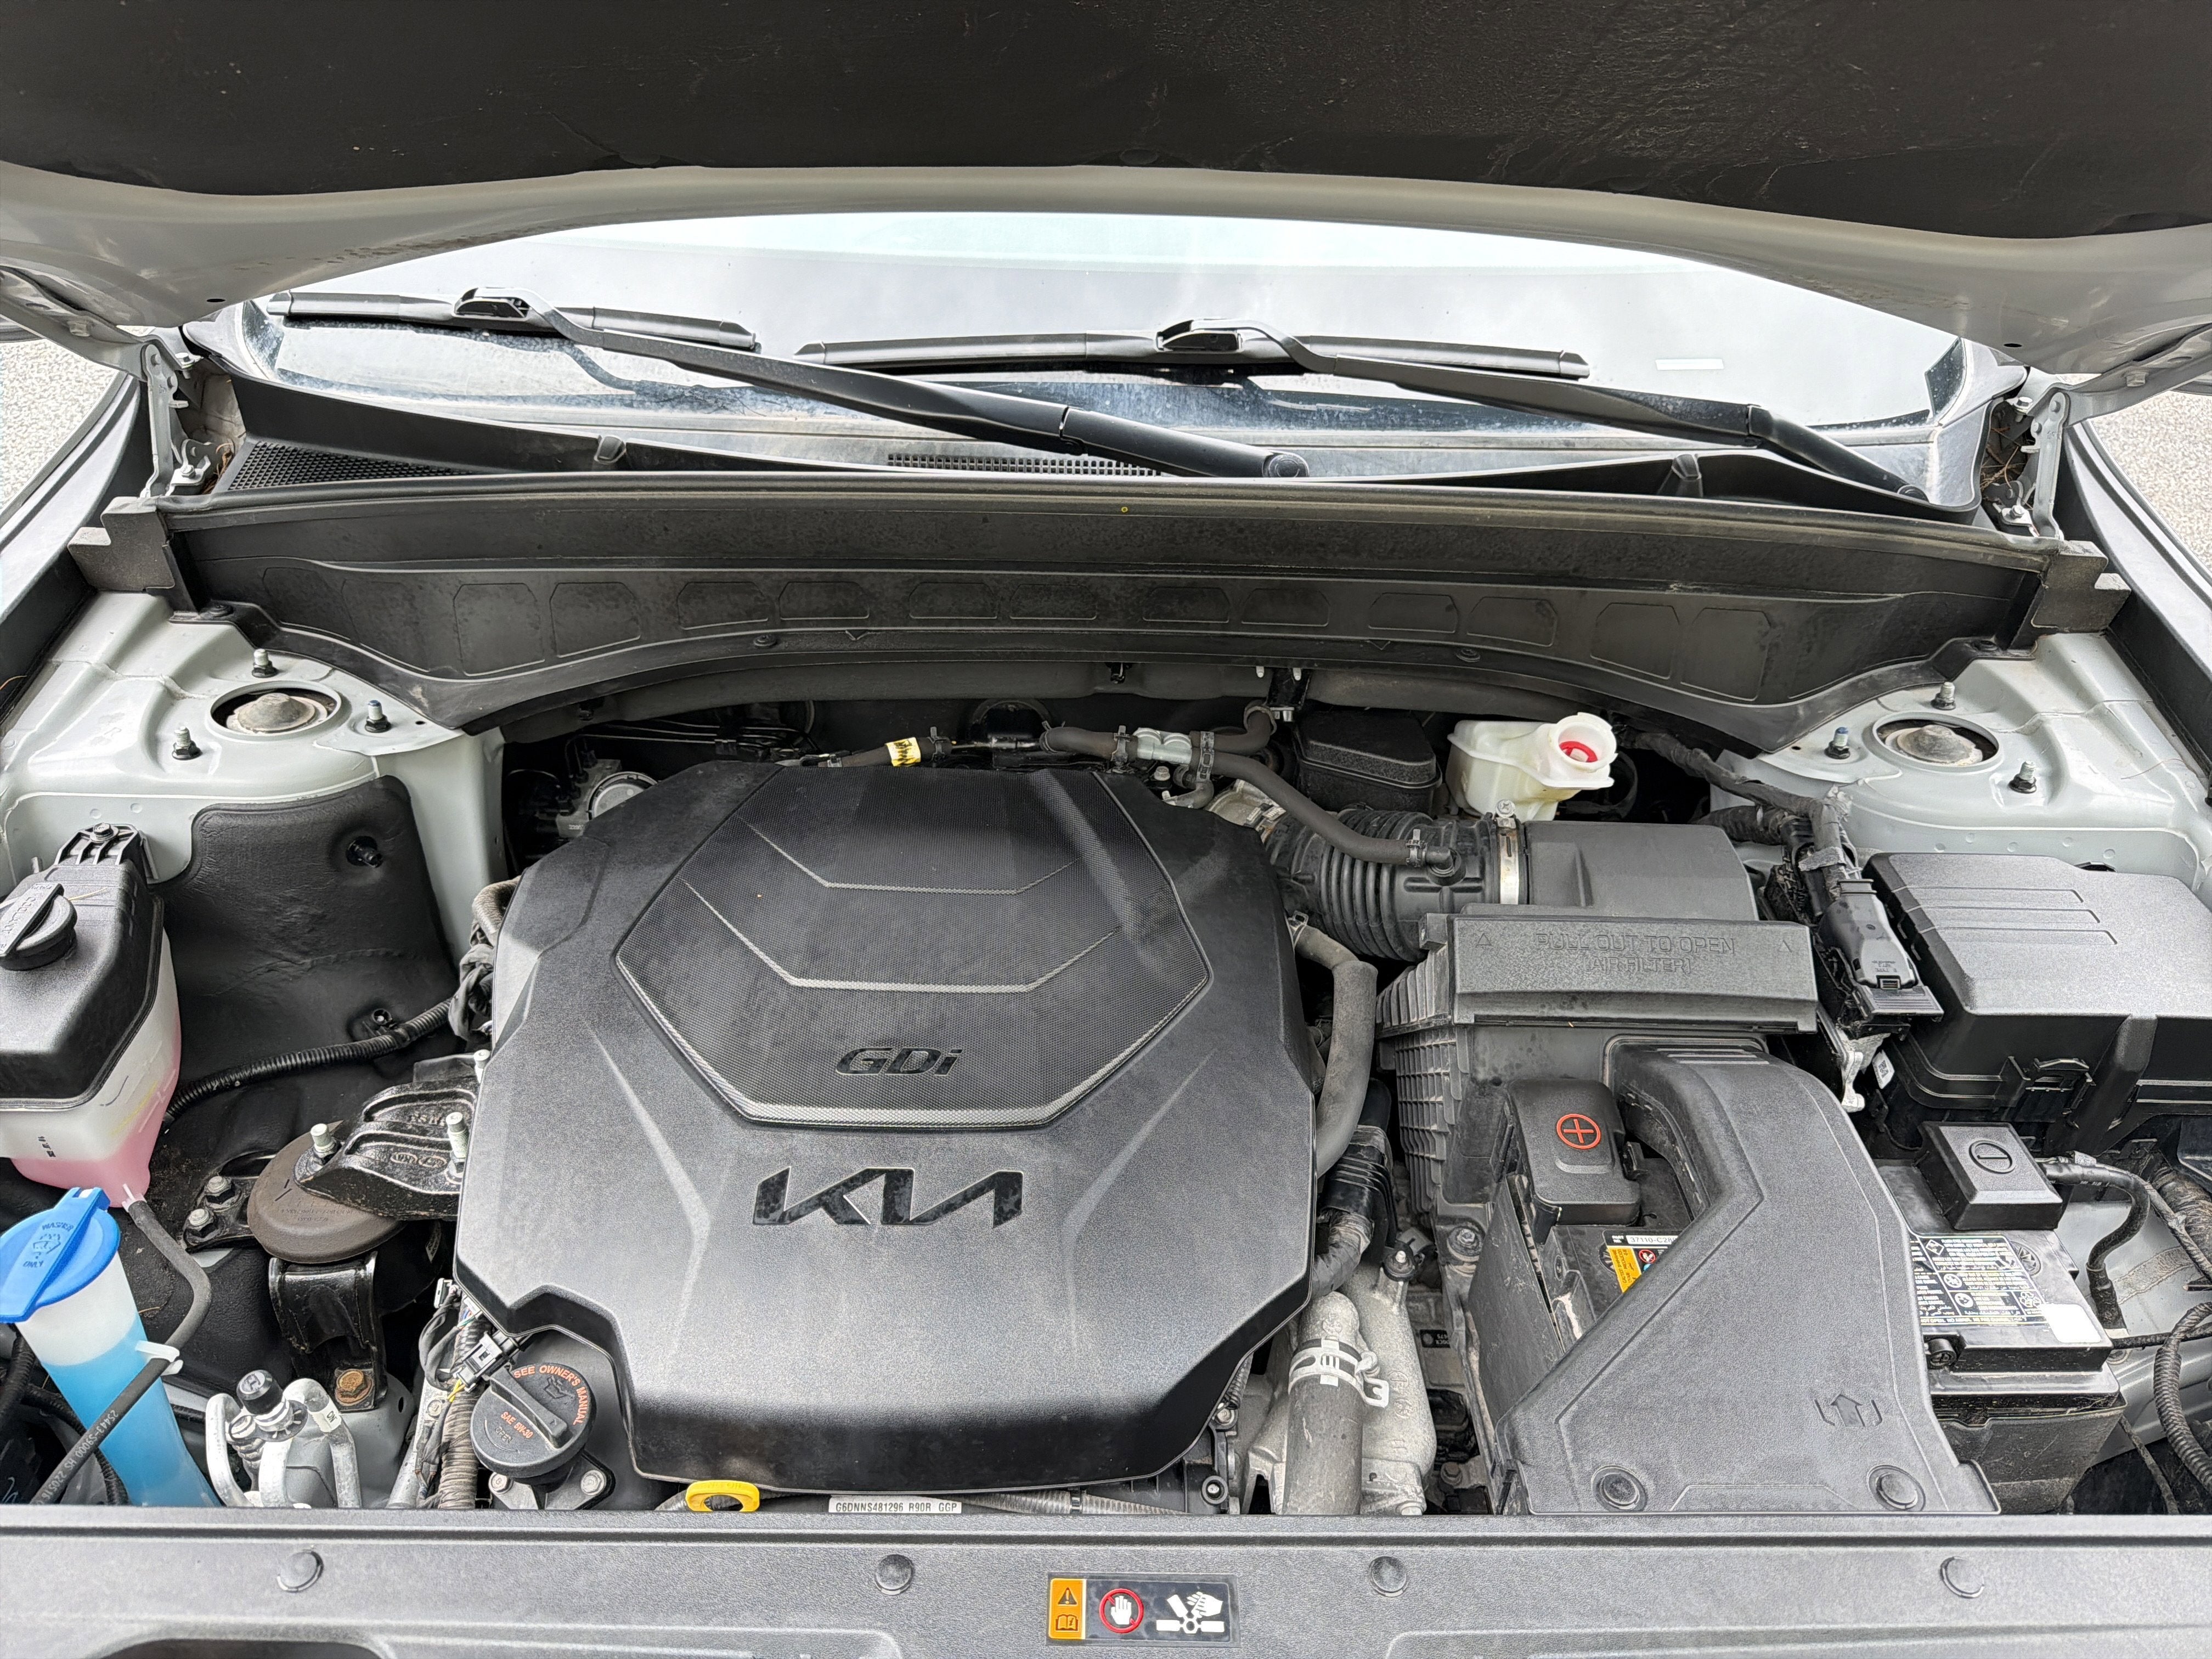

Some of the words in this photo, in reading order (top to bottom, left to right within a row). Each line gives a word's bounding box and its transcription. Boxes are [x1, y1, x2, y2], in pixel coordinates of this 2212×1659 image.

[1536, 933, 1590, 950] PULL
[1595, 934, 1638, 951] OUT
[1644, 935, 1672, 952] TO
[1679, 936, 1734, 954] OPEN
[836, 1047, 963, 1076] GDi
[752, 1166, 1024, 1228] KIA
[514, 1365, 535, 1379] SEE
[539, 1365, 581, 1386] OWNER'S
[572, 1386, 589, 1425] MANUAL
[326, 1410, 337, 1423] ON
[500, 1411, 516, 1425] SAE
[514, 1422, 534, 1438] 5W-30
[75, 1409, 119, 1458] 25443-S9000
[495, 1426, 513, 1444] OPEN
[64, 1458, 77, 1471] HS
[41, 1471, 67, 1500] 220516
[836, 1502, 904, 1512] G6DNNS481296
[909, 1503, 932, 1512] R90R
[939, 1503, 957, 1512] GGP
